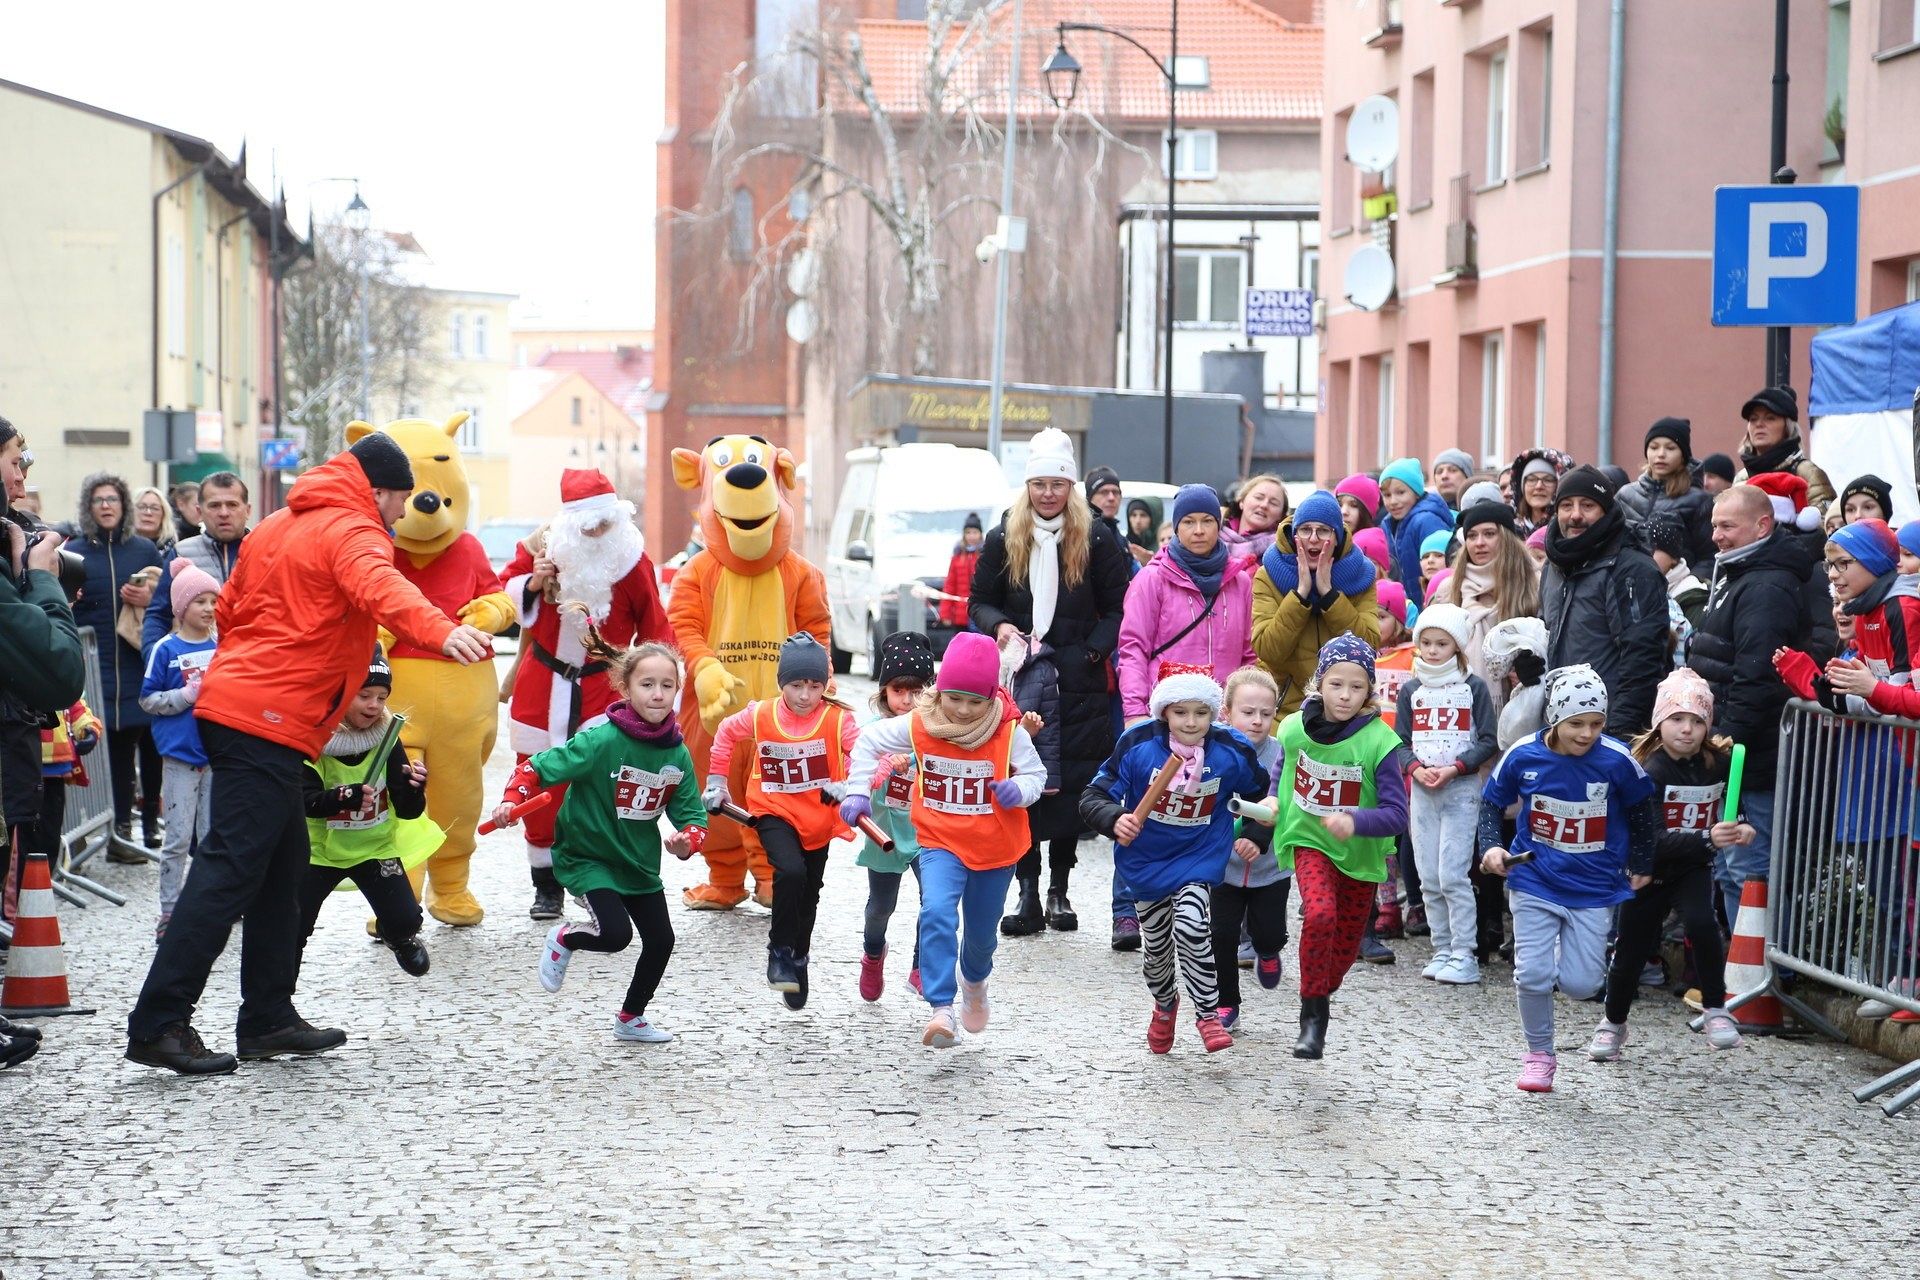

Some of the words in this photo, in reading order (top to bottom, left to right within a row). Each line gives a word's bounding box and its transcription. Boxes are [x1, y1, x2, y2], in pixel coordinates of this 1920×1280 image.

[1747, 201, 1829, 310] P
[1248, 290, 1311, 308] DRUK
[1248, 308, 1311, 322] KSERO
[717, 654, 748, 663] LICZNA
[1427, 708, 1459, 730] 4-2
[778, 758, 810, 784] 1-1
[924, 778, 942, 787] SJSP
[631, 785, 666, 810] 8-1
[942, 777, 985, 805] 11-1
[1306, 776, 1342, 806] 2-1
[1165, 793, 1205, 818] 5-1
[1681, 802, 1714, 829] 9-1
[1536, 818, 1548, 826] SP
[1553, 816, 1587, 844] 7-1
